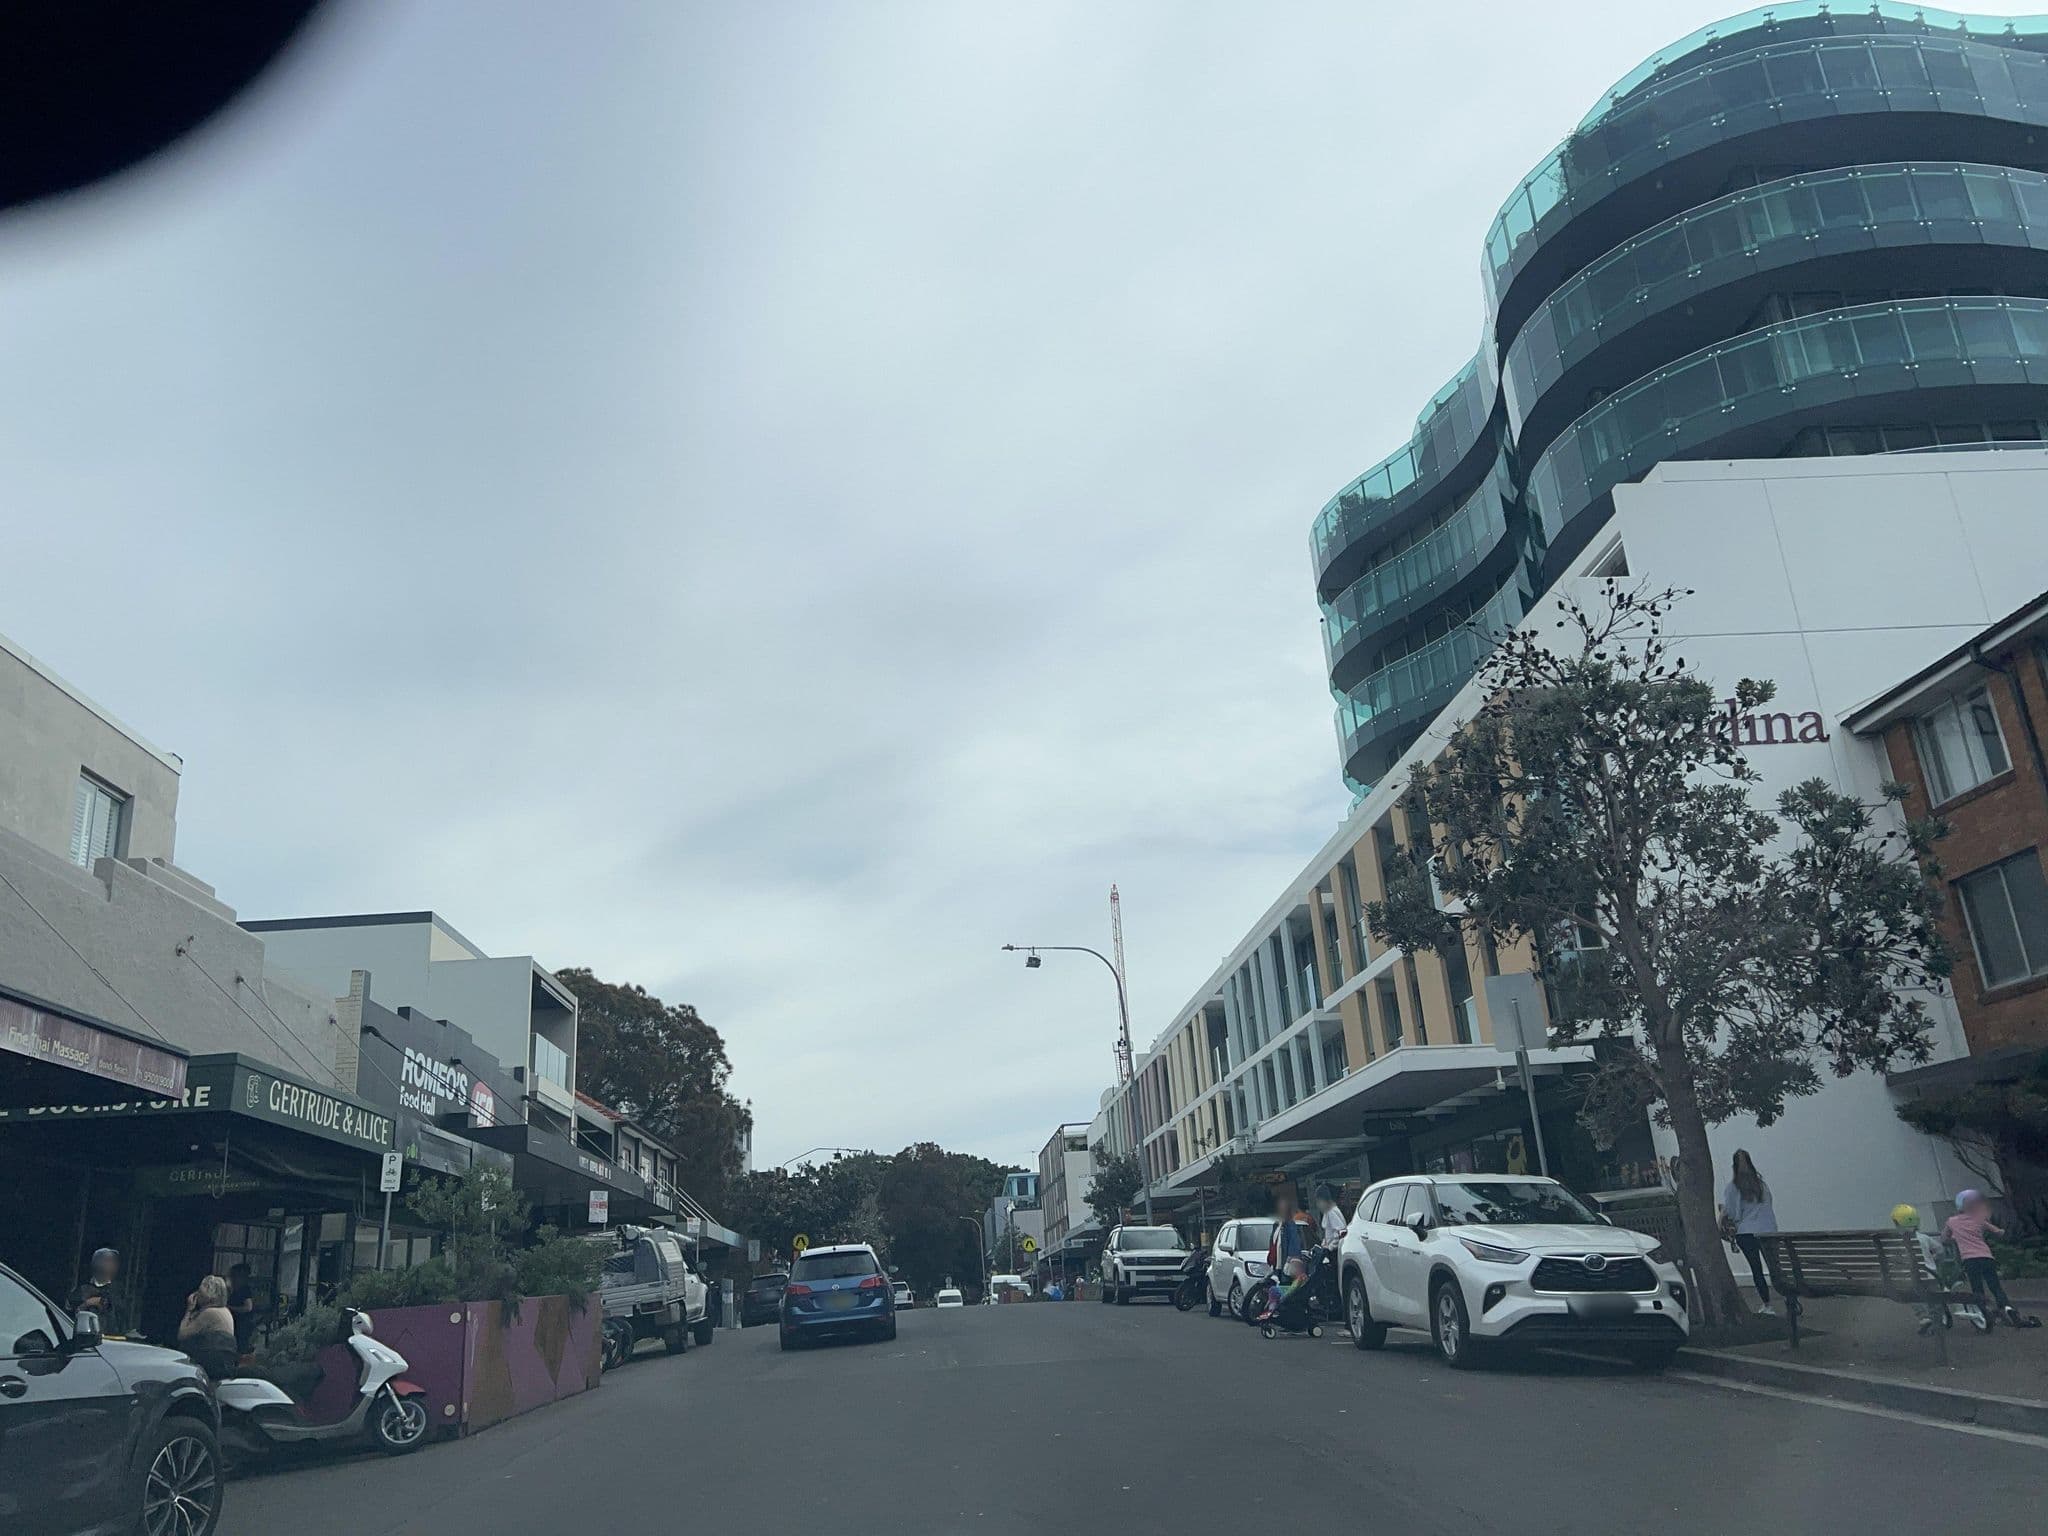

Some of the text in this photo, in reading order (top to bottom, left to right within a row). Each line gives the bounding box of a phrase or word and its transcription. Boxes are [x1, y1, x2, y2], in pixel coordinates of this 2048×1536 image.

[1672, 697, 1831, 746] dina
[52, 1040, 90, 1067] Massage
[401, 1046, 468, 1106] ROMEO'S
[269, 1080, 389, 1145] GERTRUDE & ALICE
[400, 1085, 436, 1116] Food Hall
[388, 1155, 397, 1165] P
